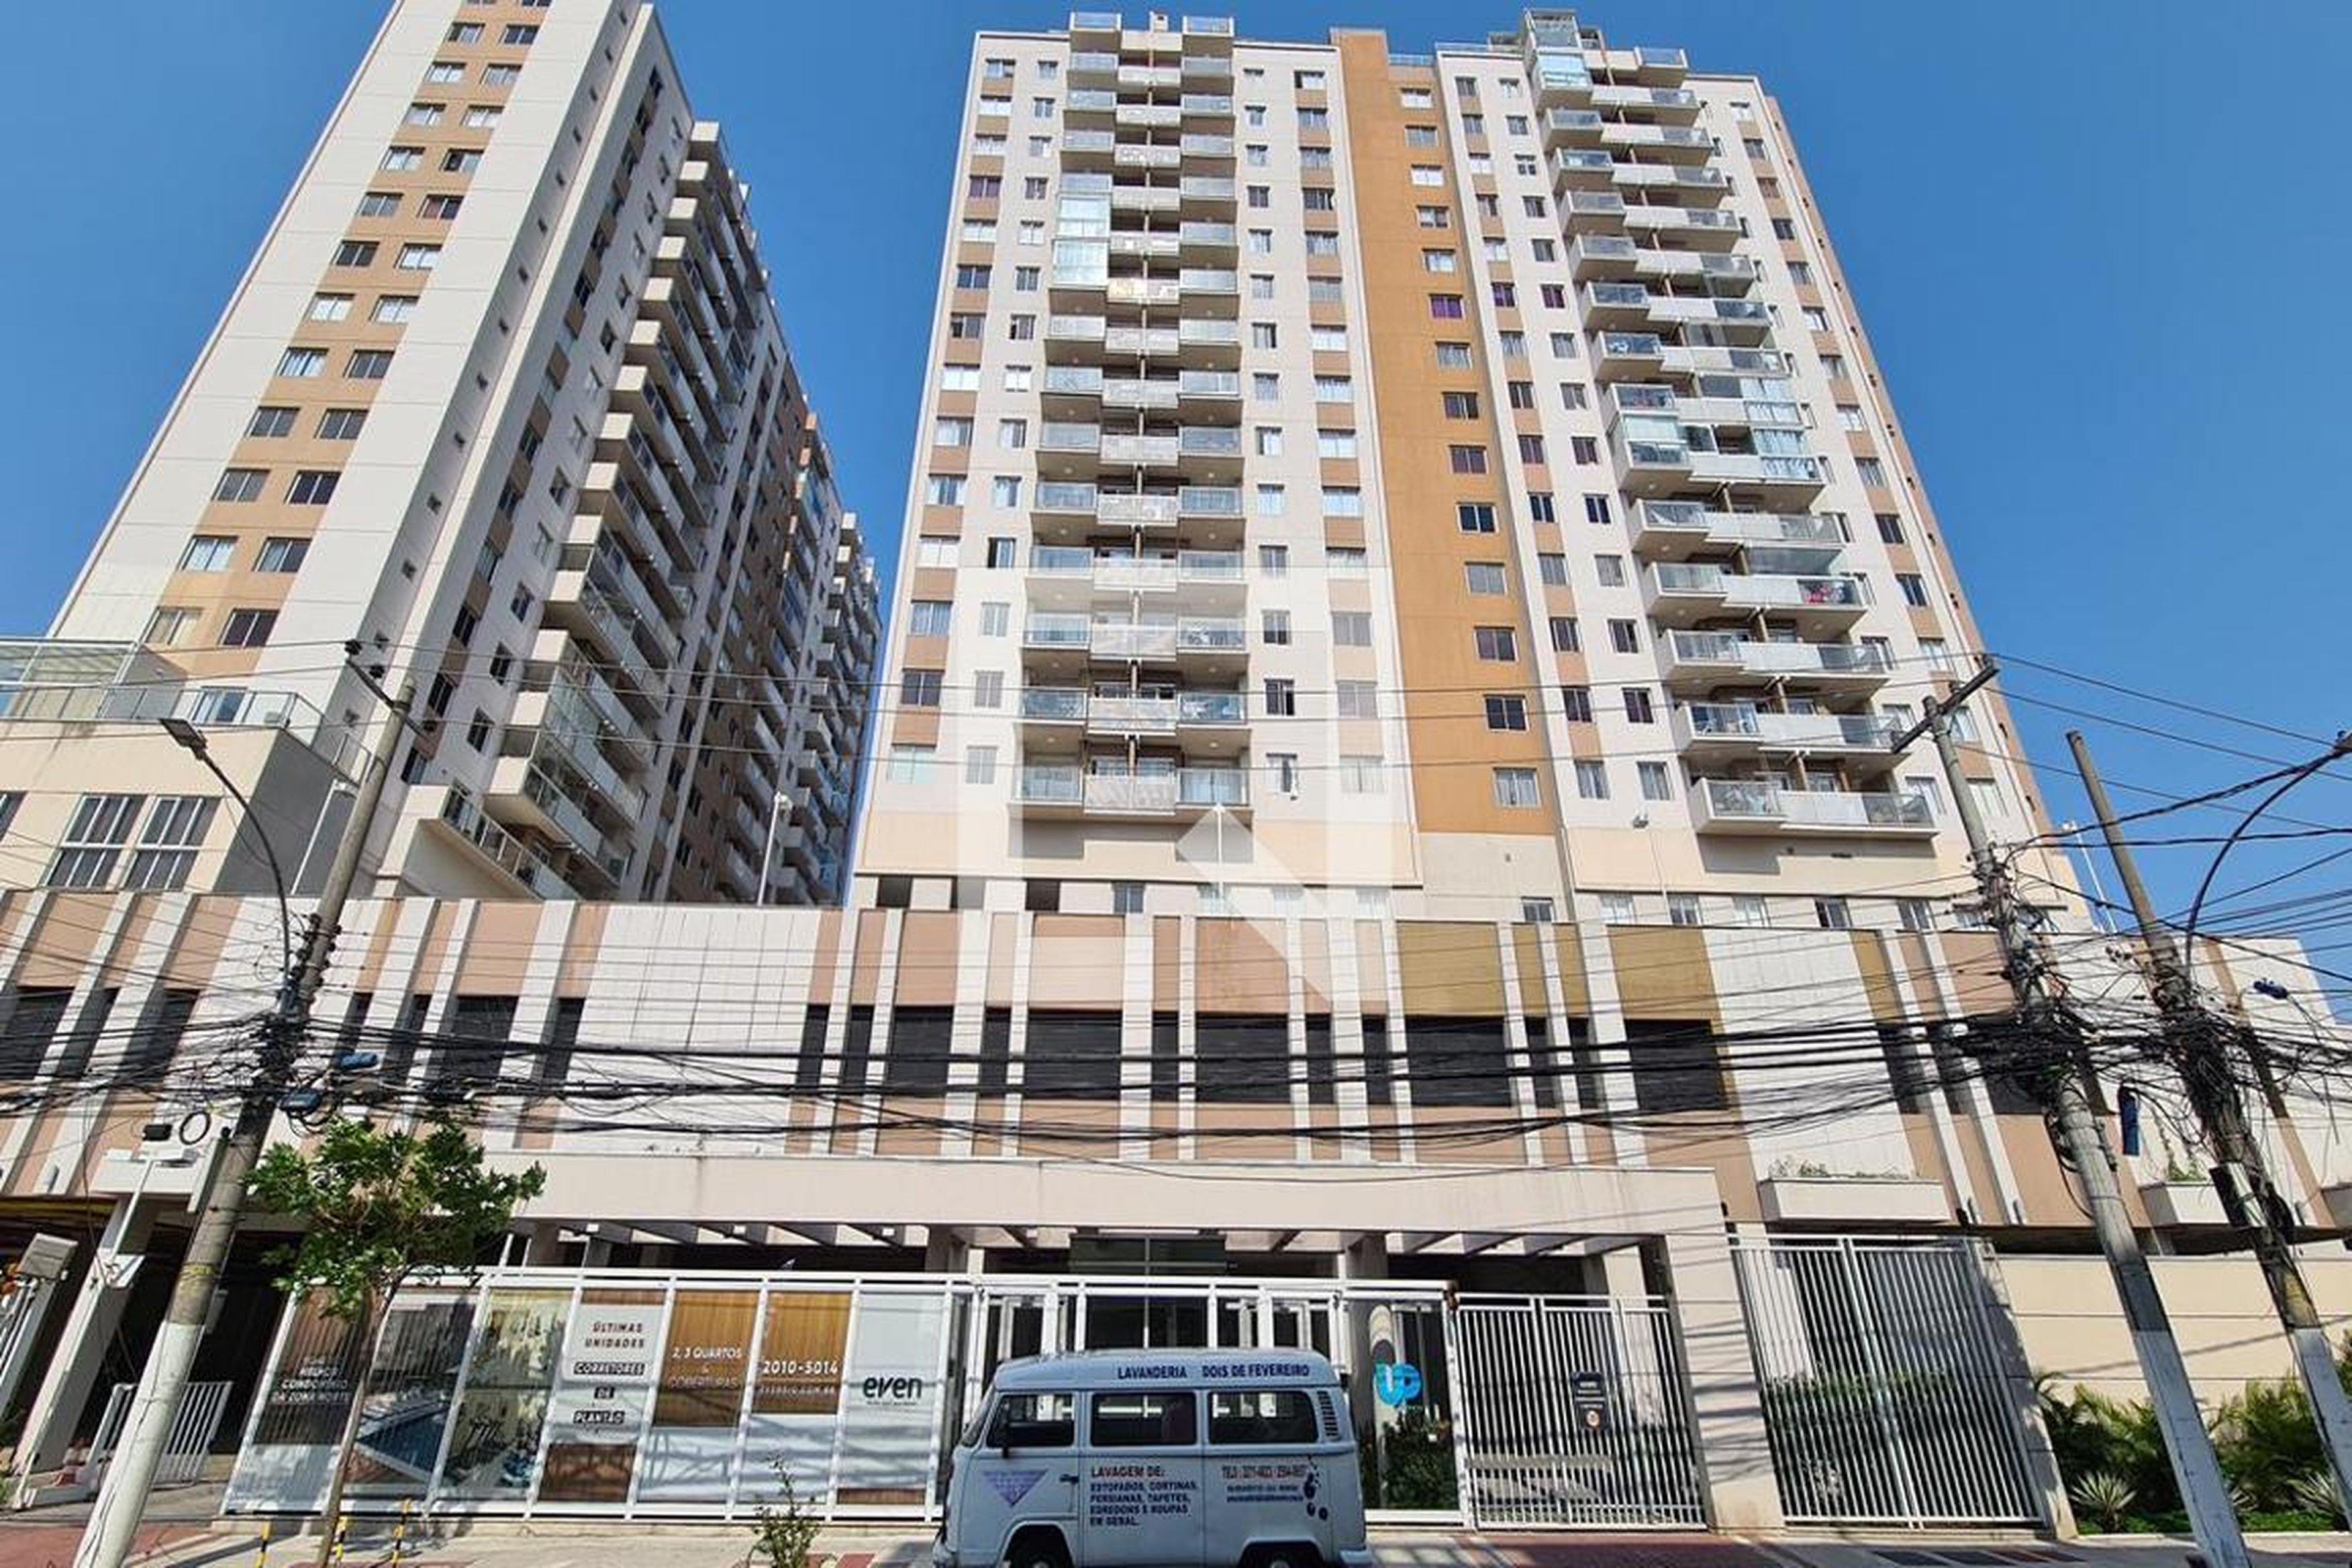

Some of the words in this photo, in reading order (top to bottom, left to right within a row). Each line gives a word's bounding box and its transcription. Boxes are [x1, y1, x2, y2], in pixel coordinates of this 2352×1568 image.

[586, 1339, 644, 1348] UNIDADES
[1118, 1365, 1188, 1379] LAVANDERIA
[1202, 1365, 1229, 1378] DOIS
[1231, 1365, 1246, 1377] DE
[1248, 1363, 1311, 1377] FEVEREIRO
[863, 1378, 922, 1398] even
[1091, 1466, 1144, 1477] LAVAGEM
